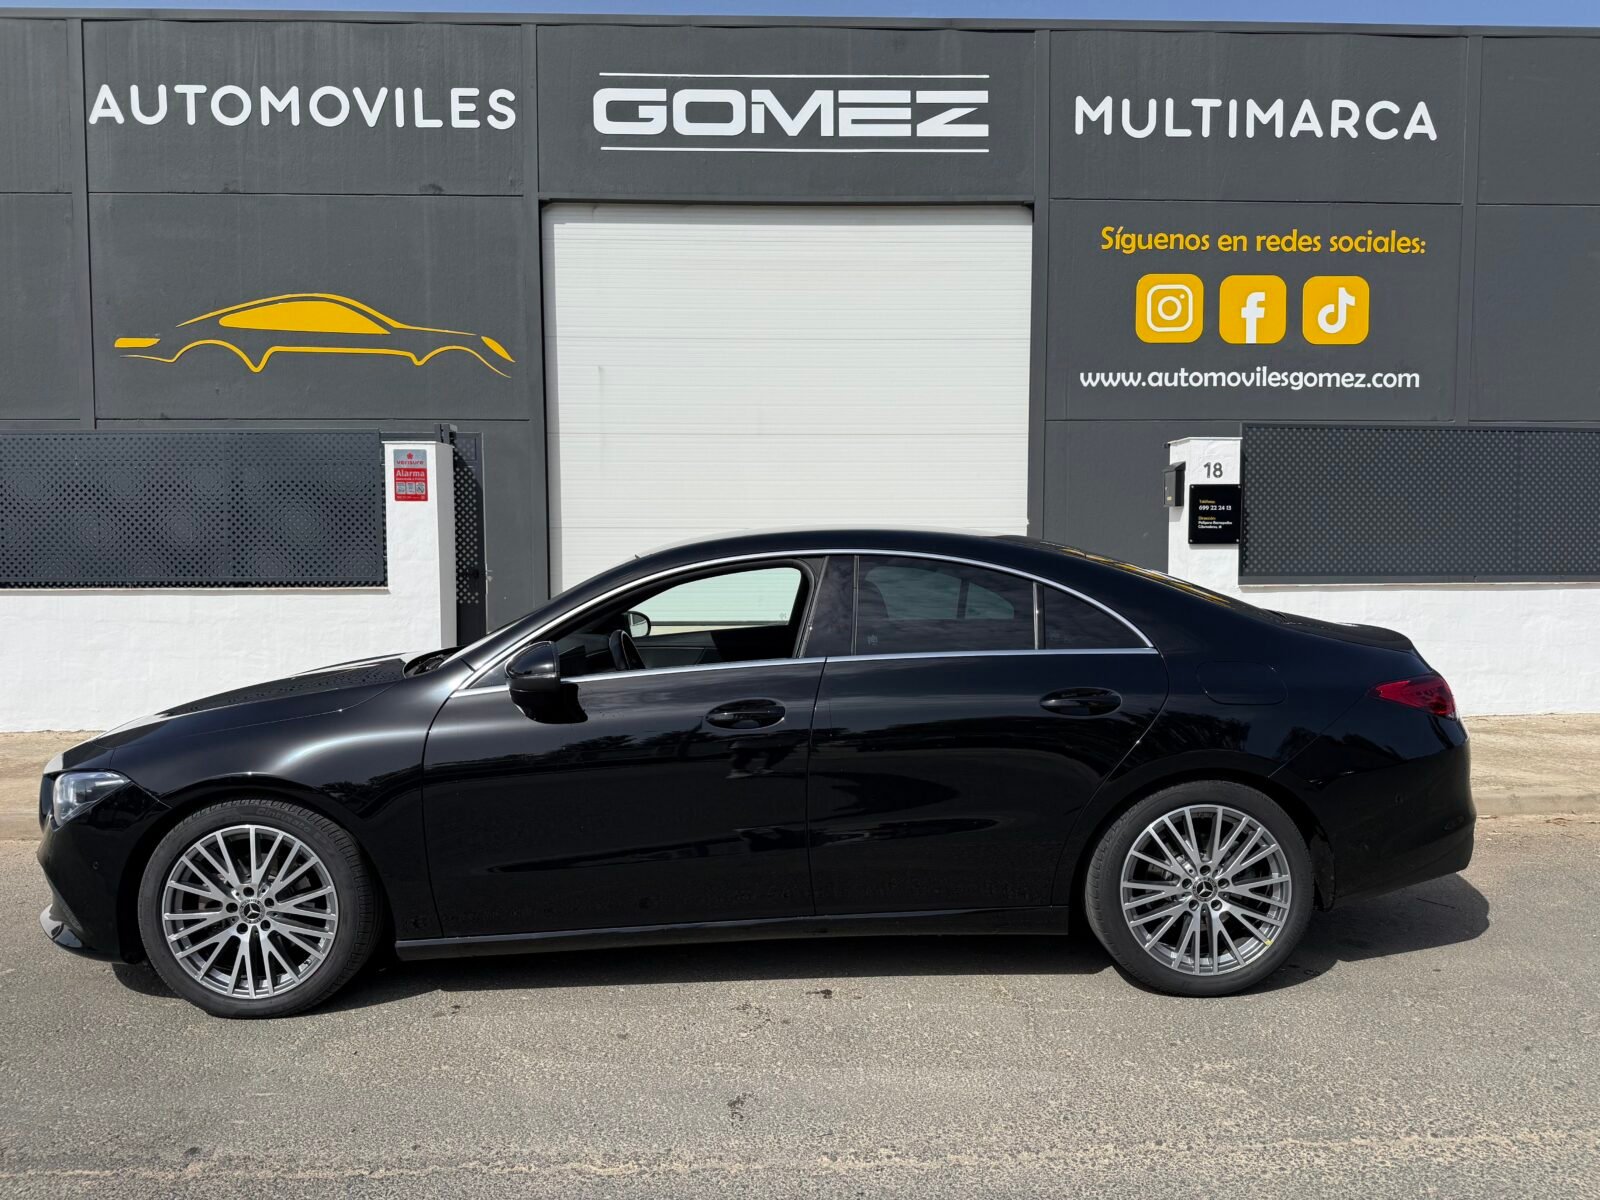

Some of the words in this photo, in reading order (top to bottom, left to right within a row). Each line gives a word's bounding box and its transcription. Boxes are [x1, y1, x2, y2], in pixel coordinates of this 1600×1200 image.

[88, 83, 517, 130] AUTOMOVILES
[592, 87, 990, 137] GOMEZ
[1074, 95, 1438, 141] MULTIMARCA
[1101, 225, 1210, 255] Síguenos
[1217, 234, 1248, 252] en
[1255, 229, 1322, 253] redes
[1329, 229, 1426, 255] sociales:
[1079, 365, 1420, 391] www.automovilesgomez.com
[396, 469, 425, 477] Alarma
[1203, 461, 1223, 479] 18
